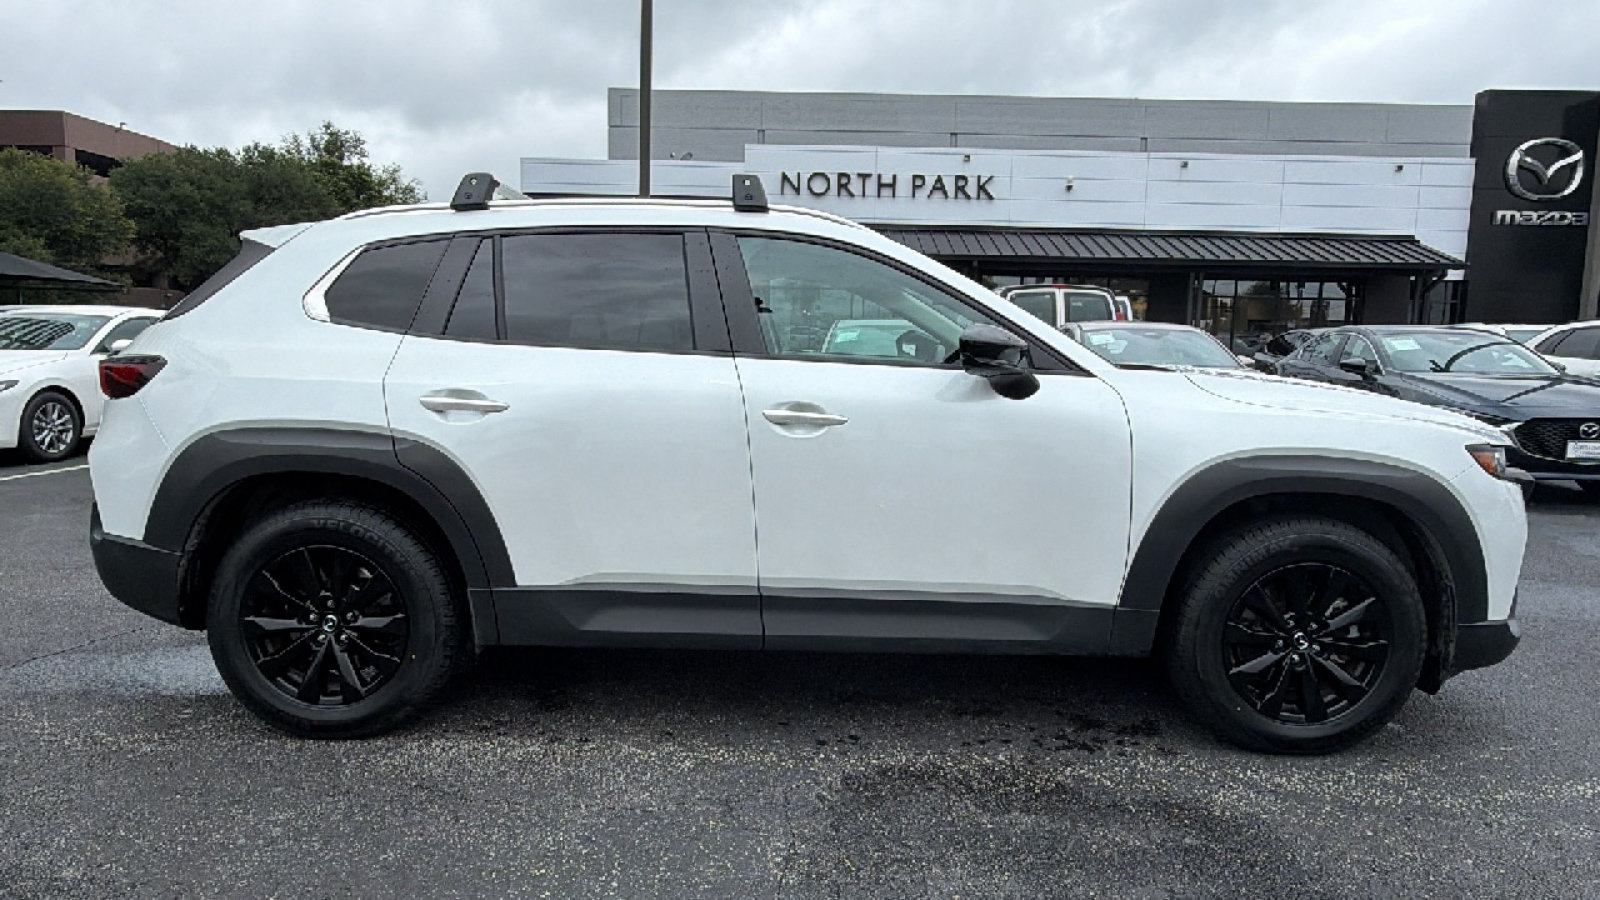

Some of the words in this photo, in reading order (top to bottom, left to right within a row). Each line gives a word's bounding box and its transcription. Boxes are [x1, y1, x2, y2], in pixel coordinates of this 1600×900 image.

[781, 171, 897, 198] NORTH
[912, 174, 995, 200] PARK
[1492, 210, 1589, 226] mazda
